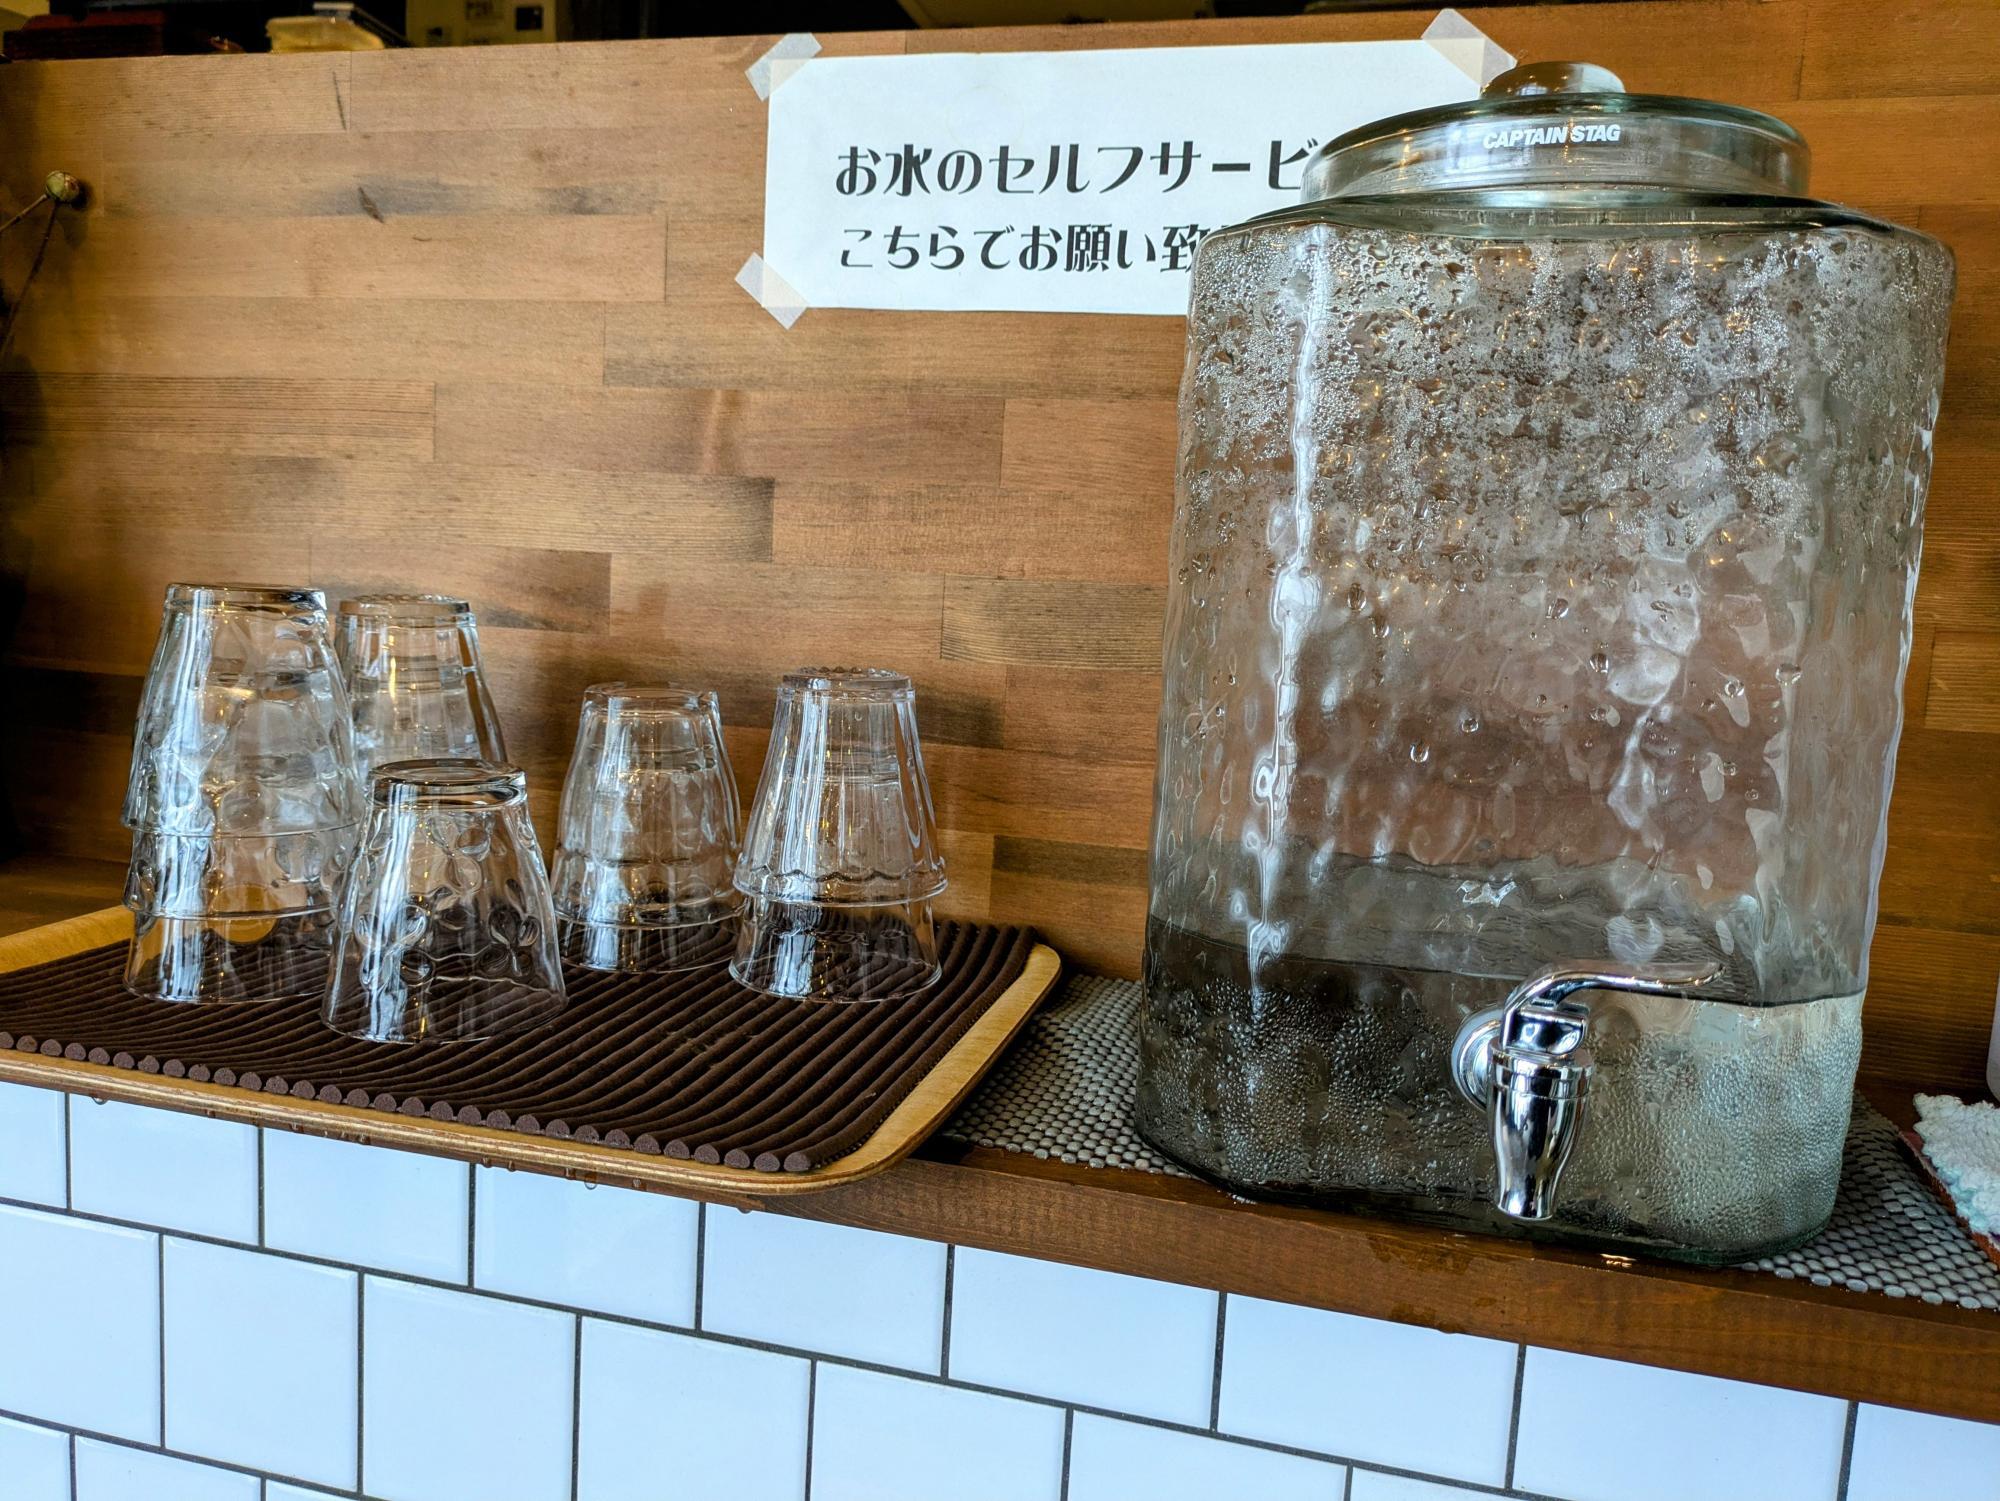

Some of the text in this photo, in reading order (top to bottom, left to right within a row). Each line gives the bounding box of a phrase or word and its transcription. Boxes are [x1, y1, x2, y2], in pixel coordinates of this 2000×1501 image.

[1483, 124, 1621, 149] CAPTAIN STAG
[835, 138, 1319, 196] お水のセルフサービ
[840, 223, 1228, 273] こちらでお願い致
